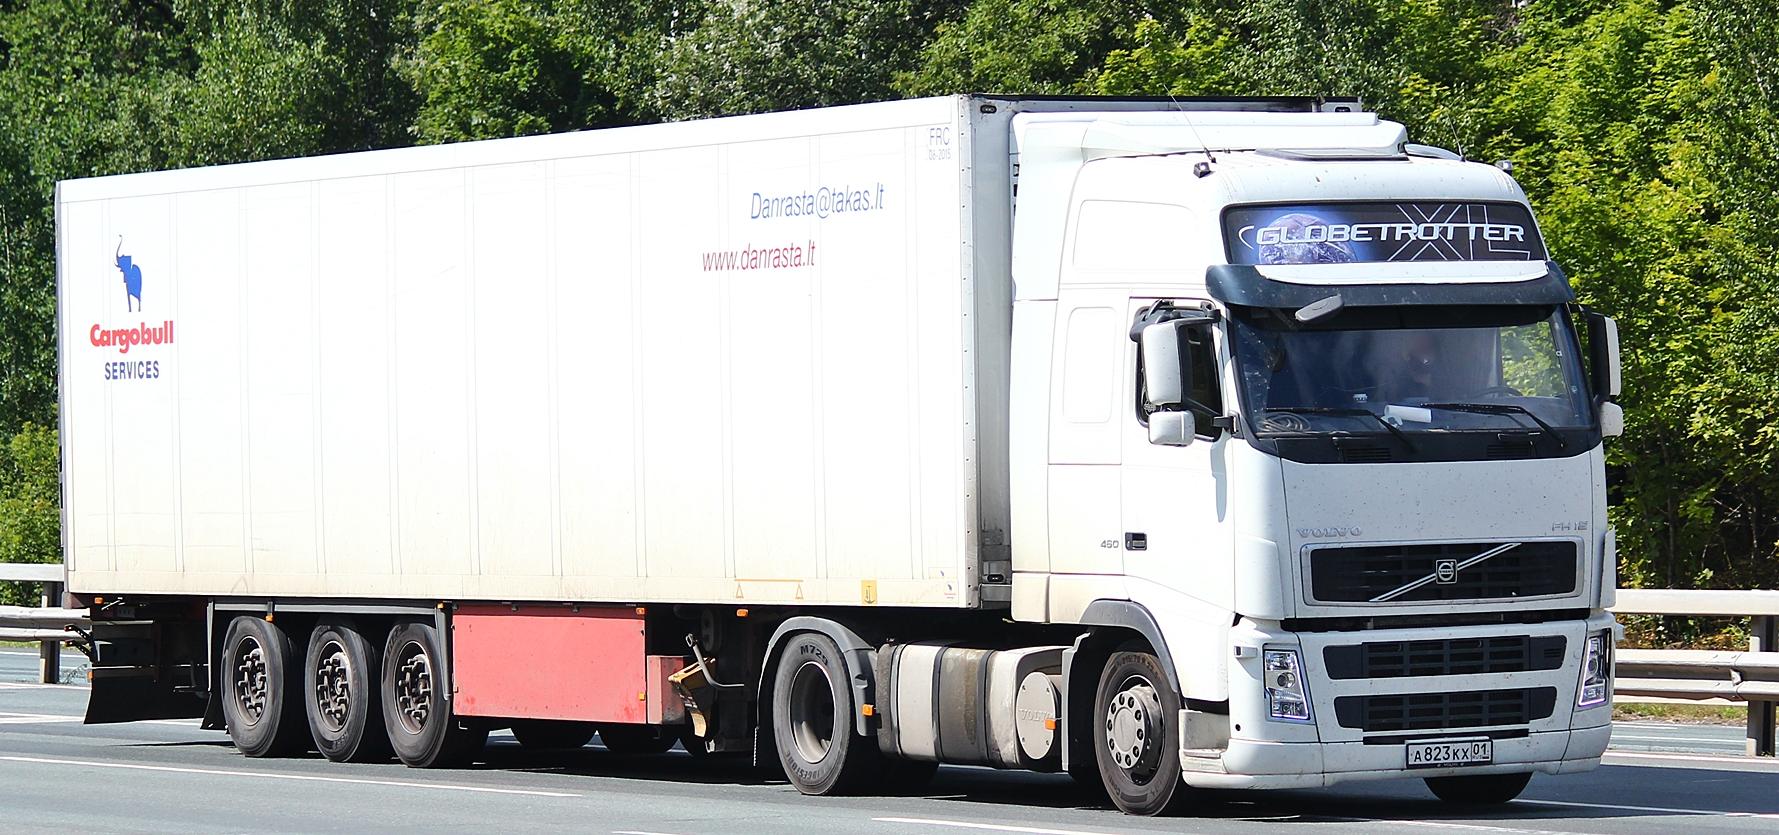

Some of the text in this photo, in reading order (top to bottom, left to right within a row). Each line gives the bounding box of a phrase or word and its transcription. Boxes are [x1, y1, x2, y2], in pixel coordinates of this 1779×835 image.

[929, 126, 950, 146] FRC
[750, 182, 884, 219] Danrasta@takas.lt
[1256, 223, 1525, 246] GLOBETROTTER
[702, 239, 816, 272] www.danrasta.lt
[90, 320, 174, 353] Cargobull
[104, 360, 160, 380] SERVICES
[1296, 526, 1362, 539] VOLVO
[1473, 743, 1488, 755] 01
